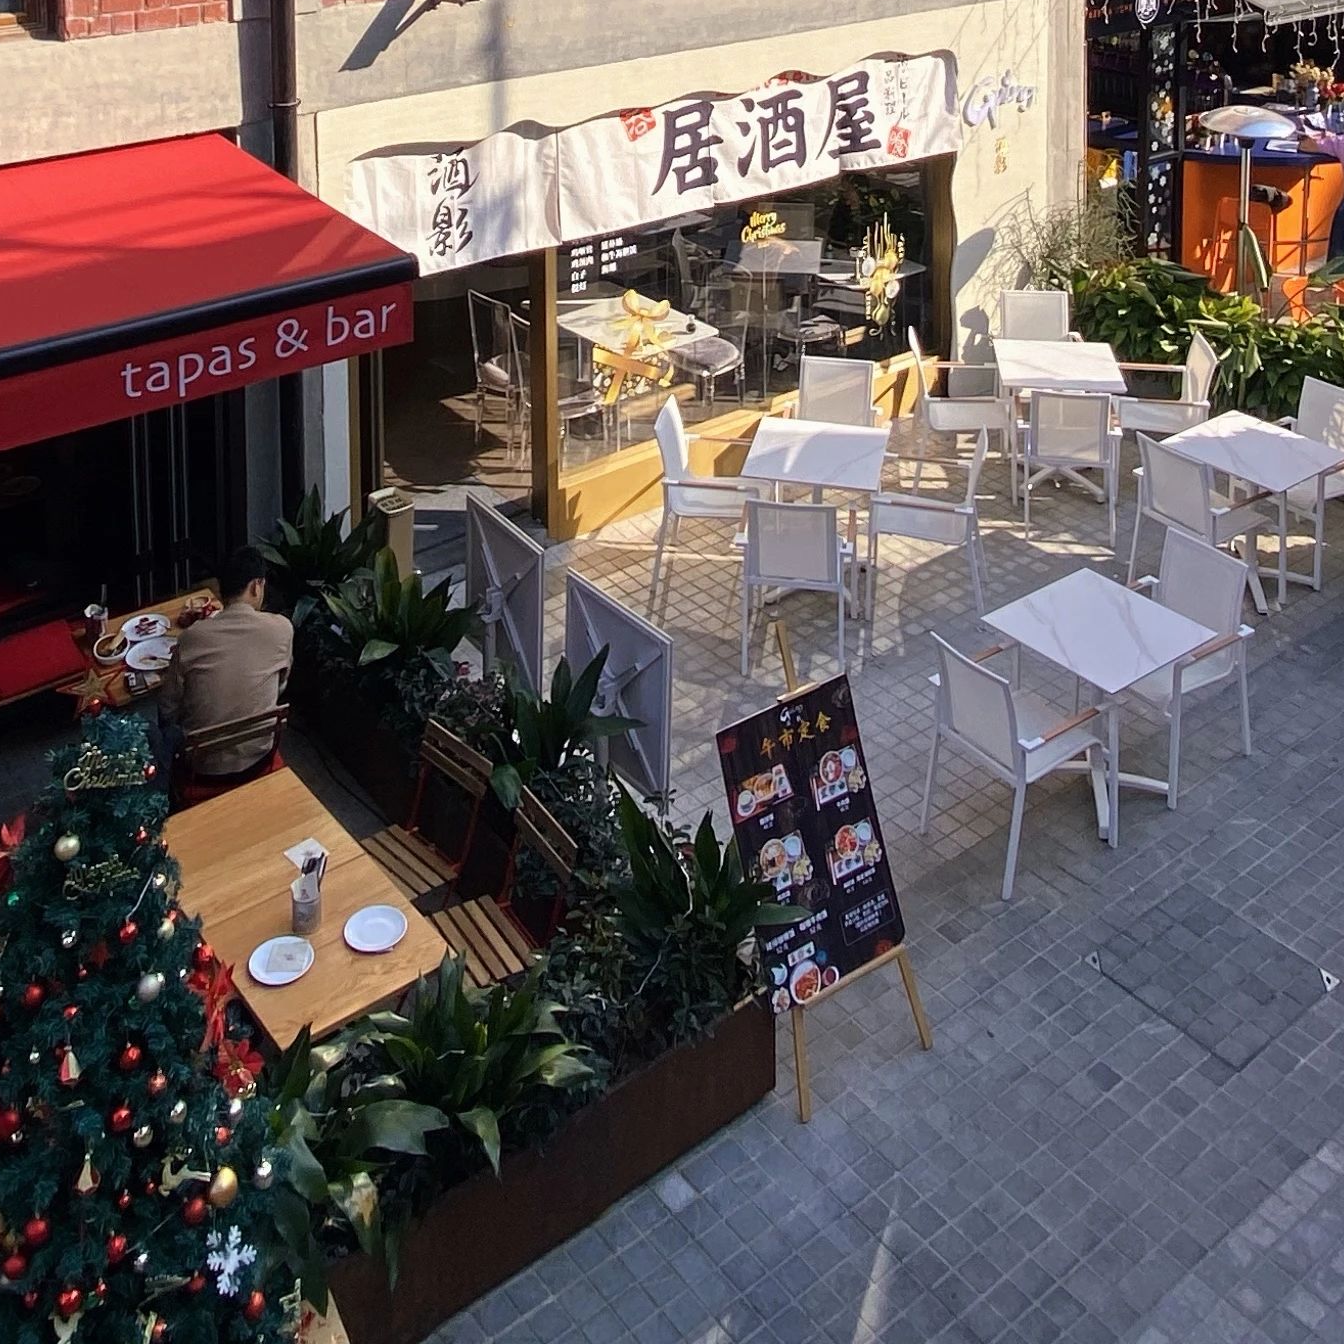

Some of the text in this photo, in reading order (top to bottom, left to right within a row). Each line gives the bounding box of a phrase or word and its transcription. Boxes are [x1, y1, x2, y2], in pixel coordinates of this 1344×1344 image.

[651, 70, 883, 196] 居酒屋
[426, 146, 481, 257] 酒影
[120, 302, 397, 399] tapas & bar
